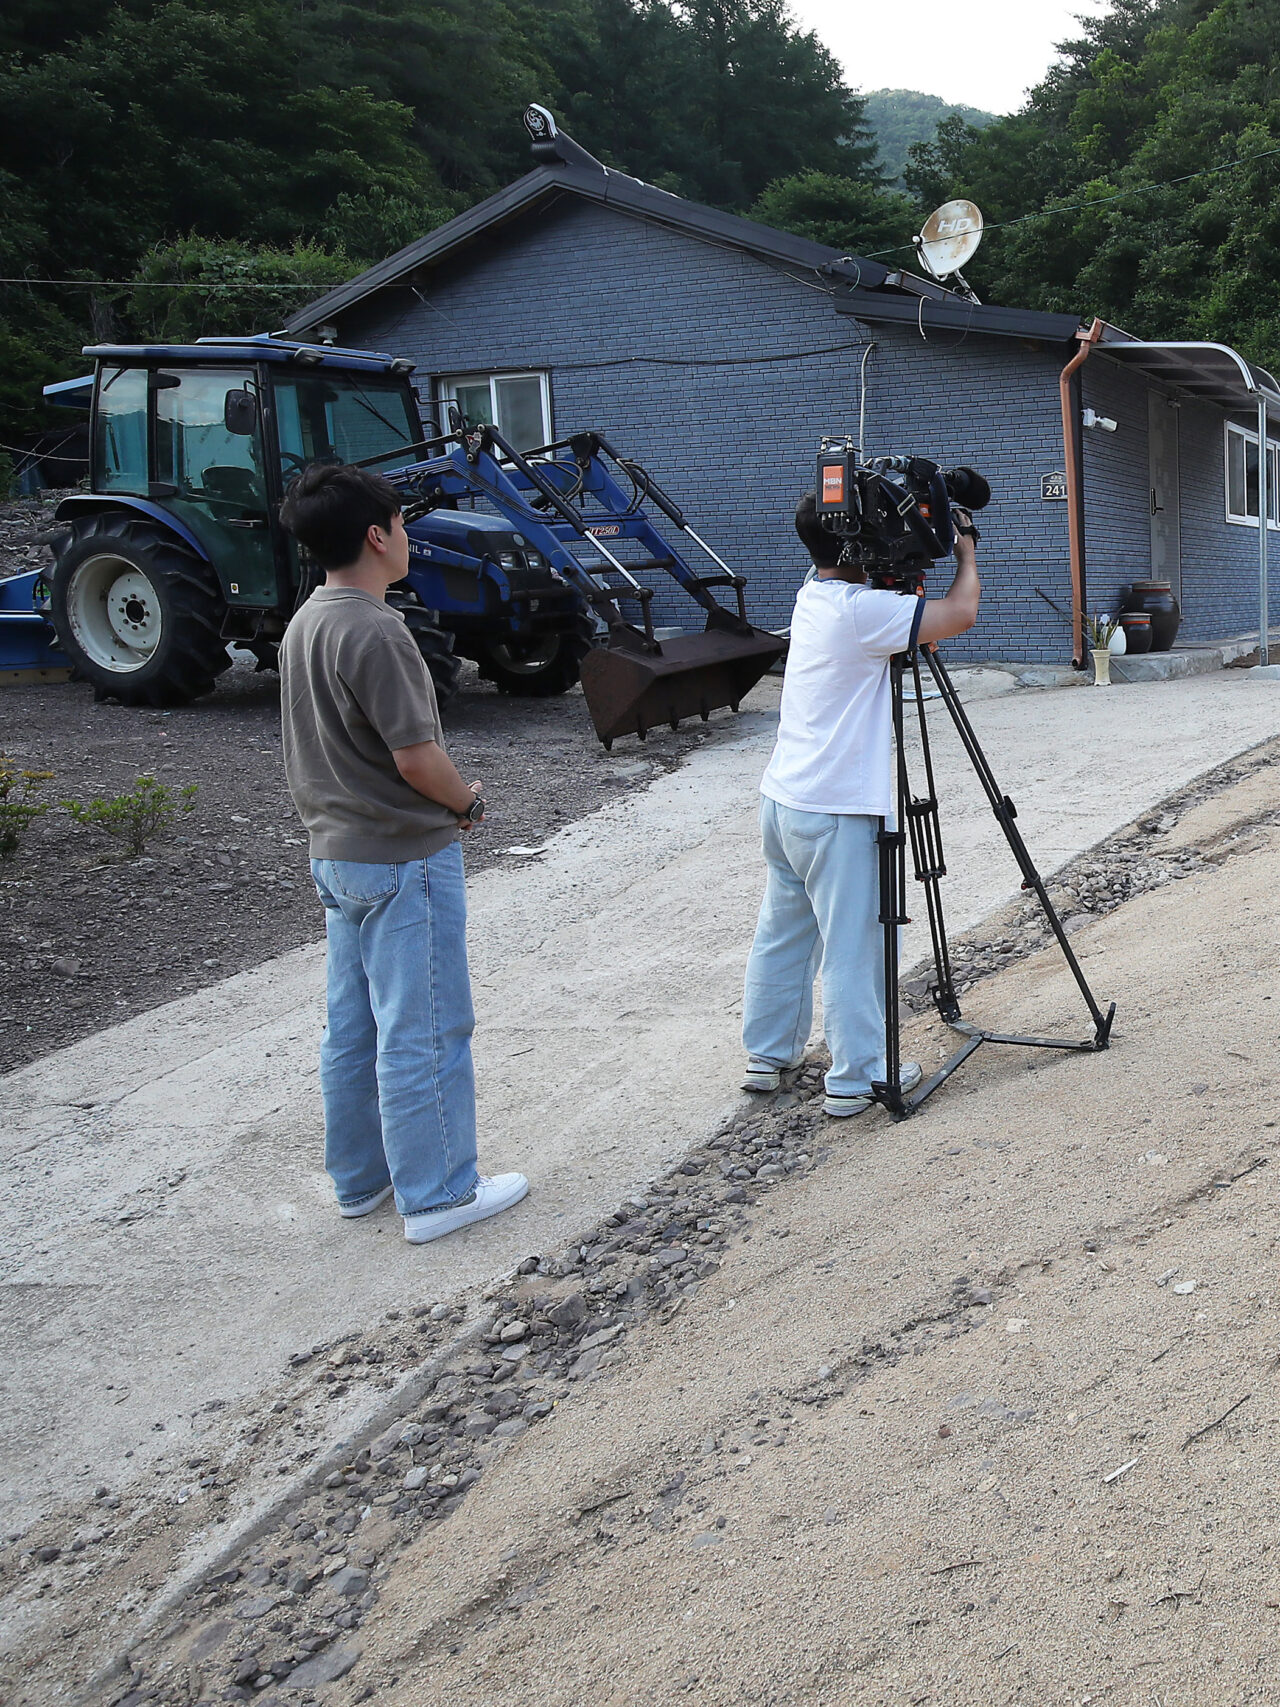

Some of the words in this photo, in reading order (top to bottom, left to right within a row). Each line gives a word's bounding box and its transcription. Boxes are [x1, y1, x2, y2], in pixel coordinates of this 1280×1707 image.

[937, 217, 971, 233] HD
[824, 477, 842, 485] MBN
[1045, 485, 1066, 496] 241
